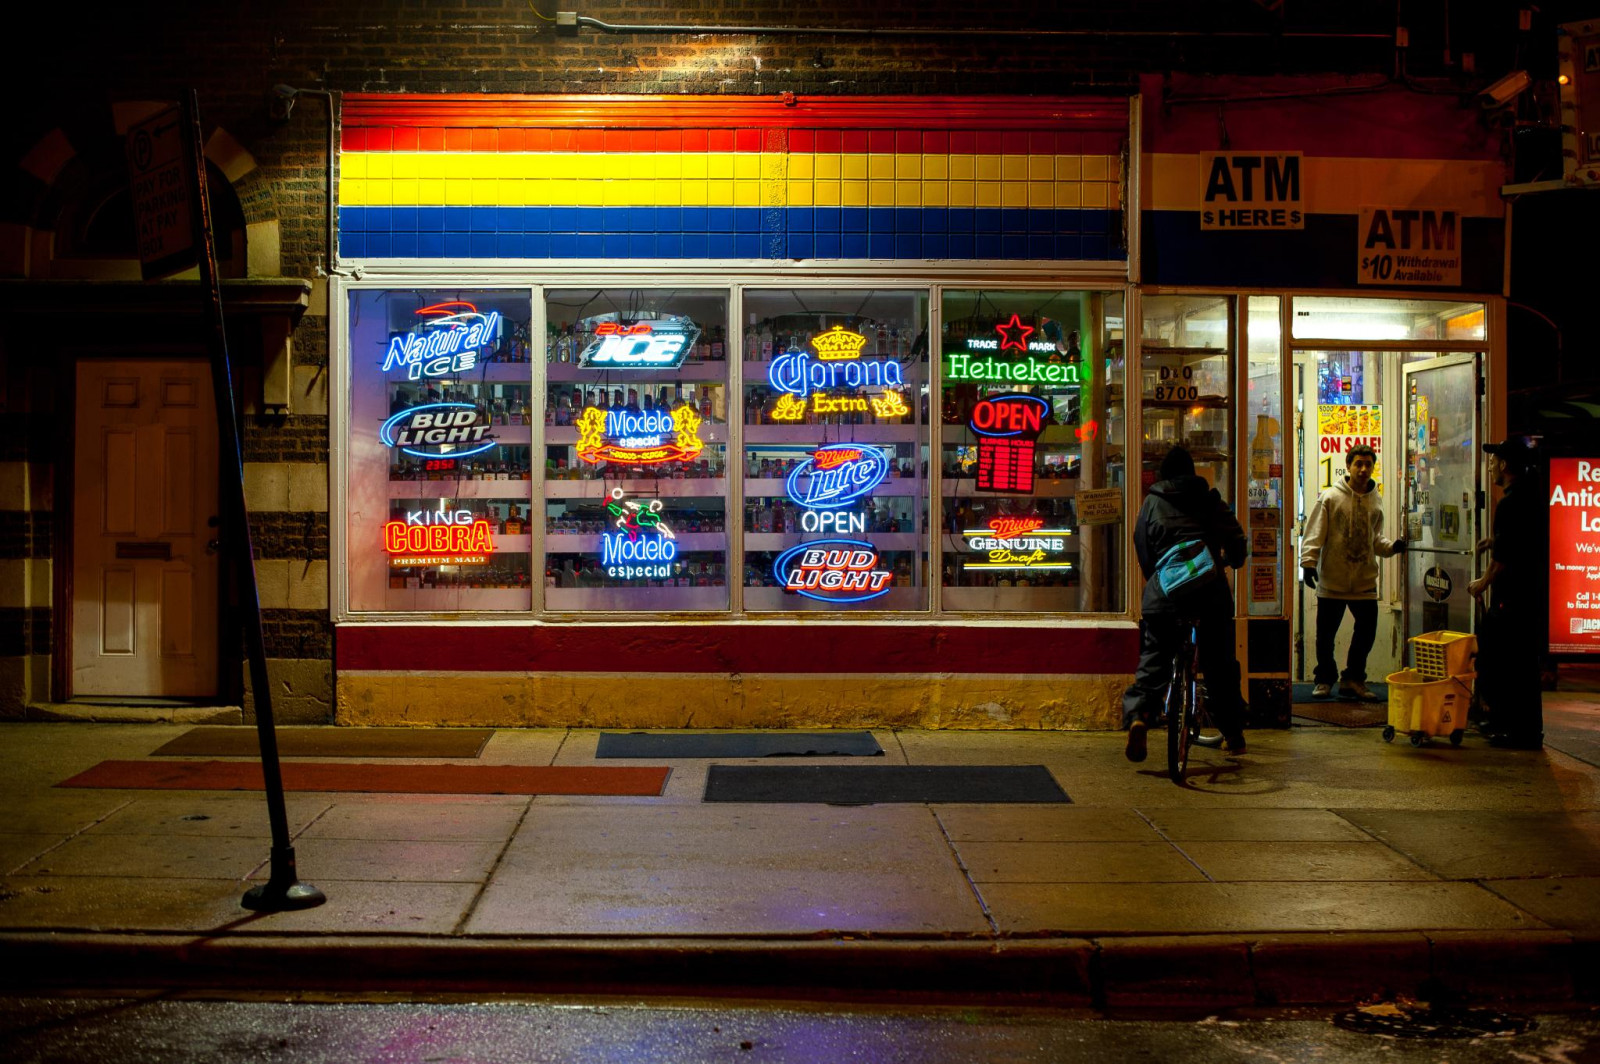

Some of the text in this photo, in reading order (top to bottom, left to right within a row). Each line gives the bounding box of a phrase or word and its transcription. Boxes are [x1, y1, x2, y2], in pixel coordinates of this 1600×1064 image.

[1204, 156, 1300, 202] ATM
[140, 189, 187, 212] PARKING
[1219, 209, 1286, 226] HERE
[1364, 209, 1456, 251] ATM
[1362, 254, 1458, 280] $10 Withdrawal
[1394, 269, 1443, 282] Available
[382, 311, 498, 372] Natural
[591, 334, 686, 362] ICE
[967, 339, 1056, 352] TRADE MARK
[408, 351, 477, 381] ICE
[769, 352, 903, 397] Corona
[948, 354, 1080, 382] Heineken
[812, 392, 869, 413] Extra
[1155, 386, 1198, 401] 8700
[411, 411, 477, 429] BUD
[608, 410, 673, 437] Modelo
[973, 401, 1042, 432] OPEN
[396, 425, 491, 446] LIGHT
[620, 434, 660, 448] especial
[1320, 436, 1341, 453] ON
[814, 449, 863, 469] Miller
[804, 459, 876, 503] Lite
[1248, 488, 1268, 498] 8700
[407, 510, 473, 526] KING
[801, 510, 865, 533] OPEN
[988, 518, 1043, 539] Miller
[385, 521, 493, 553] COBRA
[969, 537, 1064, 551] GENUINE
[602, 533, 675, 565] Modelo
[988, 549, 1047, 565] Draft
[393, 557, 450, 565] PREMIUM
[800, 549, 879, 571] BUD
[608, 564, 671, 579] especial
[786, 569, 893, 591] LIGHT
[1575, 600, 1589, 608] find
[1576, 592, 1590, 600] Call
